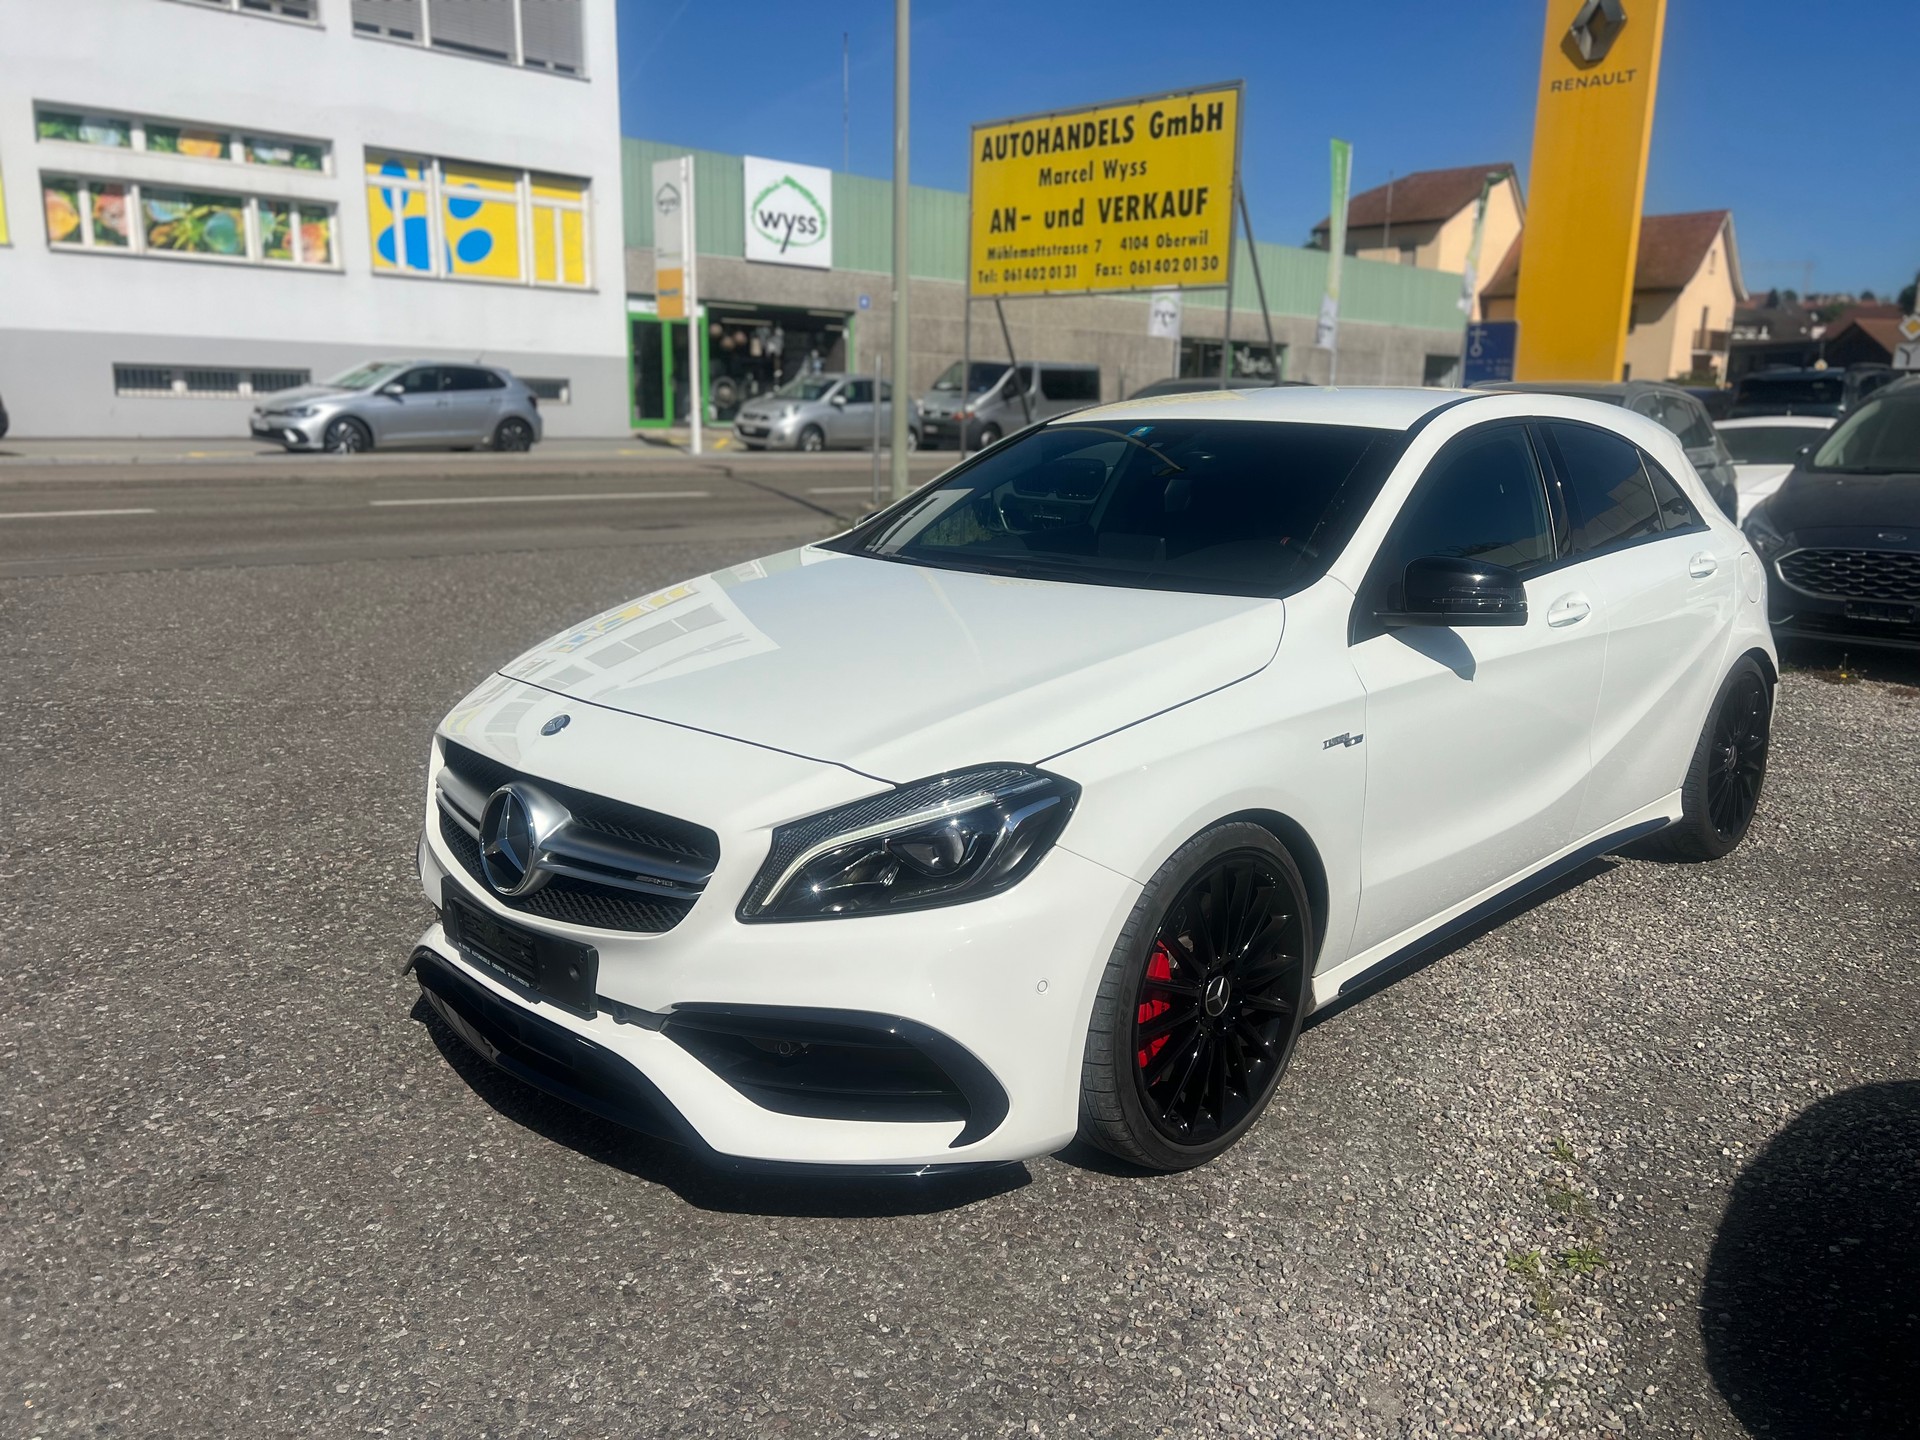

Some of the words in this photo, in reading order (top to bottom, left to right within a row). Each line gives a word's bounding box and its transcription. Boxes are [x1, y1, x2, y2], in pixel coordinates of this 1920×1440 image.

[1551, 69, 1637, 93] RENAULT
[981, 115, 1135, 162] AUTOHANDELS
[1150, 102, 1224, 140] GmbH
[1038, 160, 1094, 187] Marcel
[1103, 159, 1148, 182] Wyss
[1044, 198, 1084, 230] und
[1098, 187, 1209, 224] VERKAUF
[759, 209, 818, 255] wyss
[1094, 239, 1102, 253] 7
[1120, 235, 1149, 251] 4104
[1156, 229, 1208, 248] Oberwil
[1095, 262, 1122, 277] Fax:
